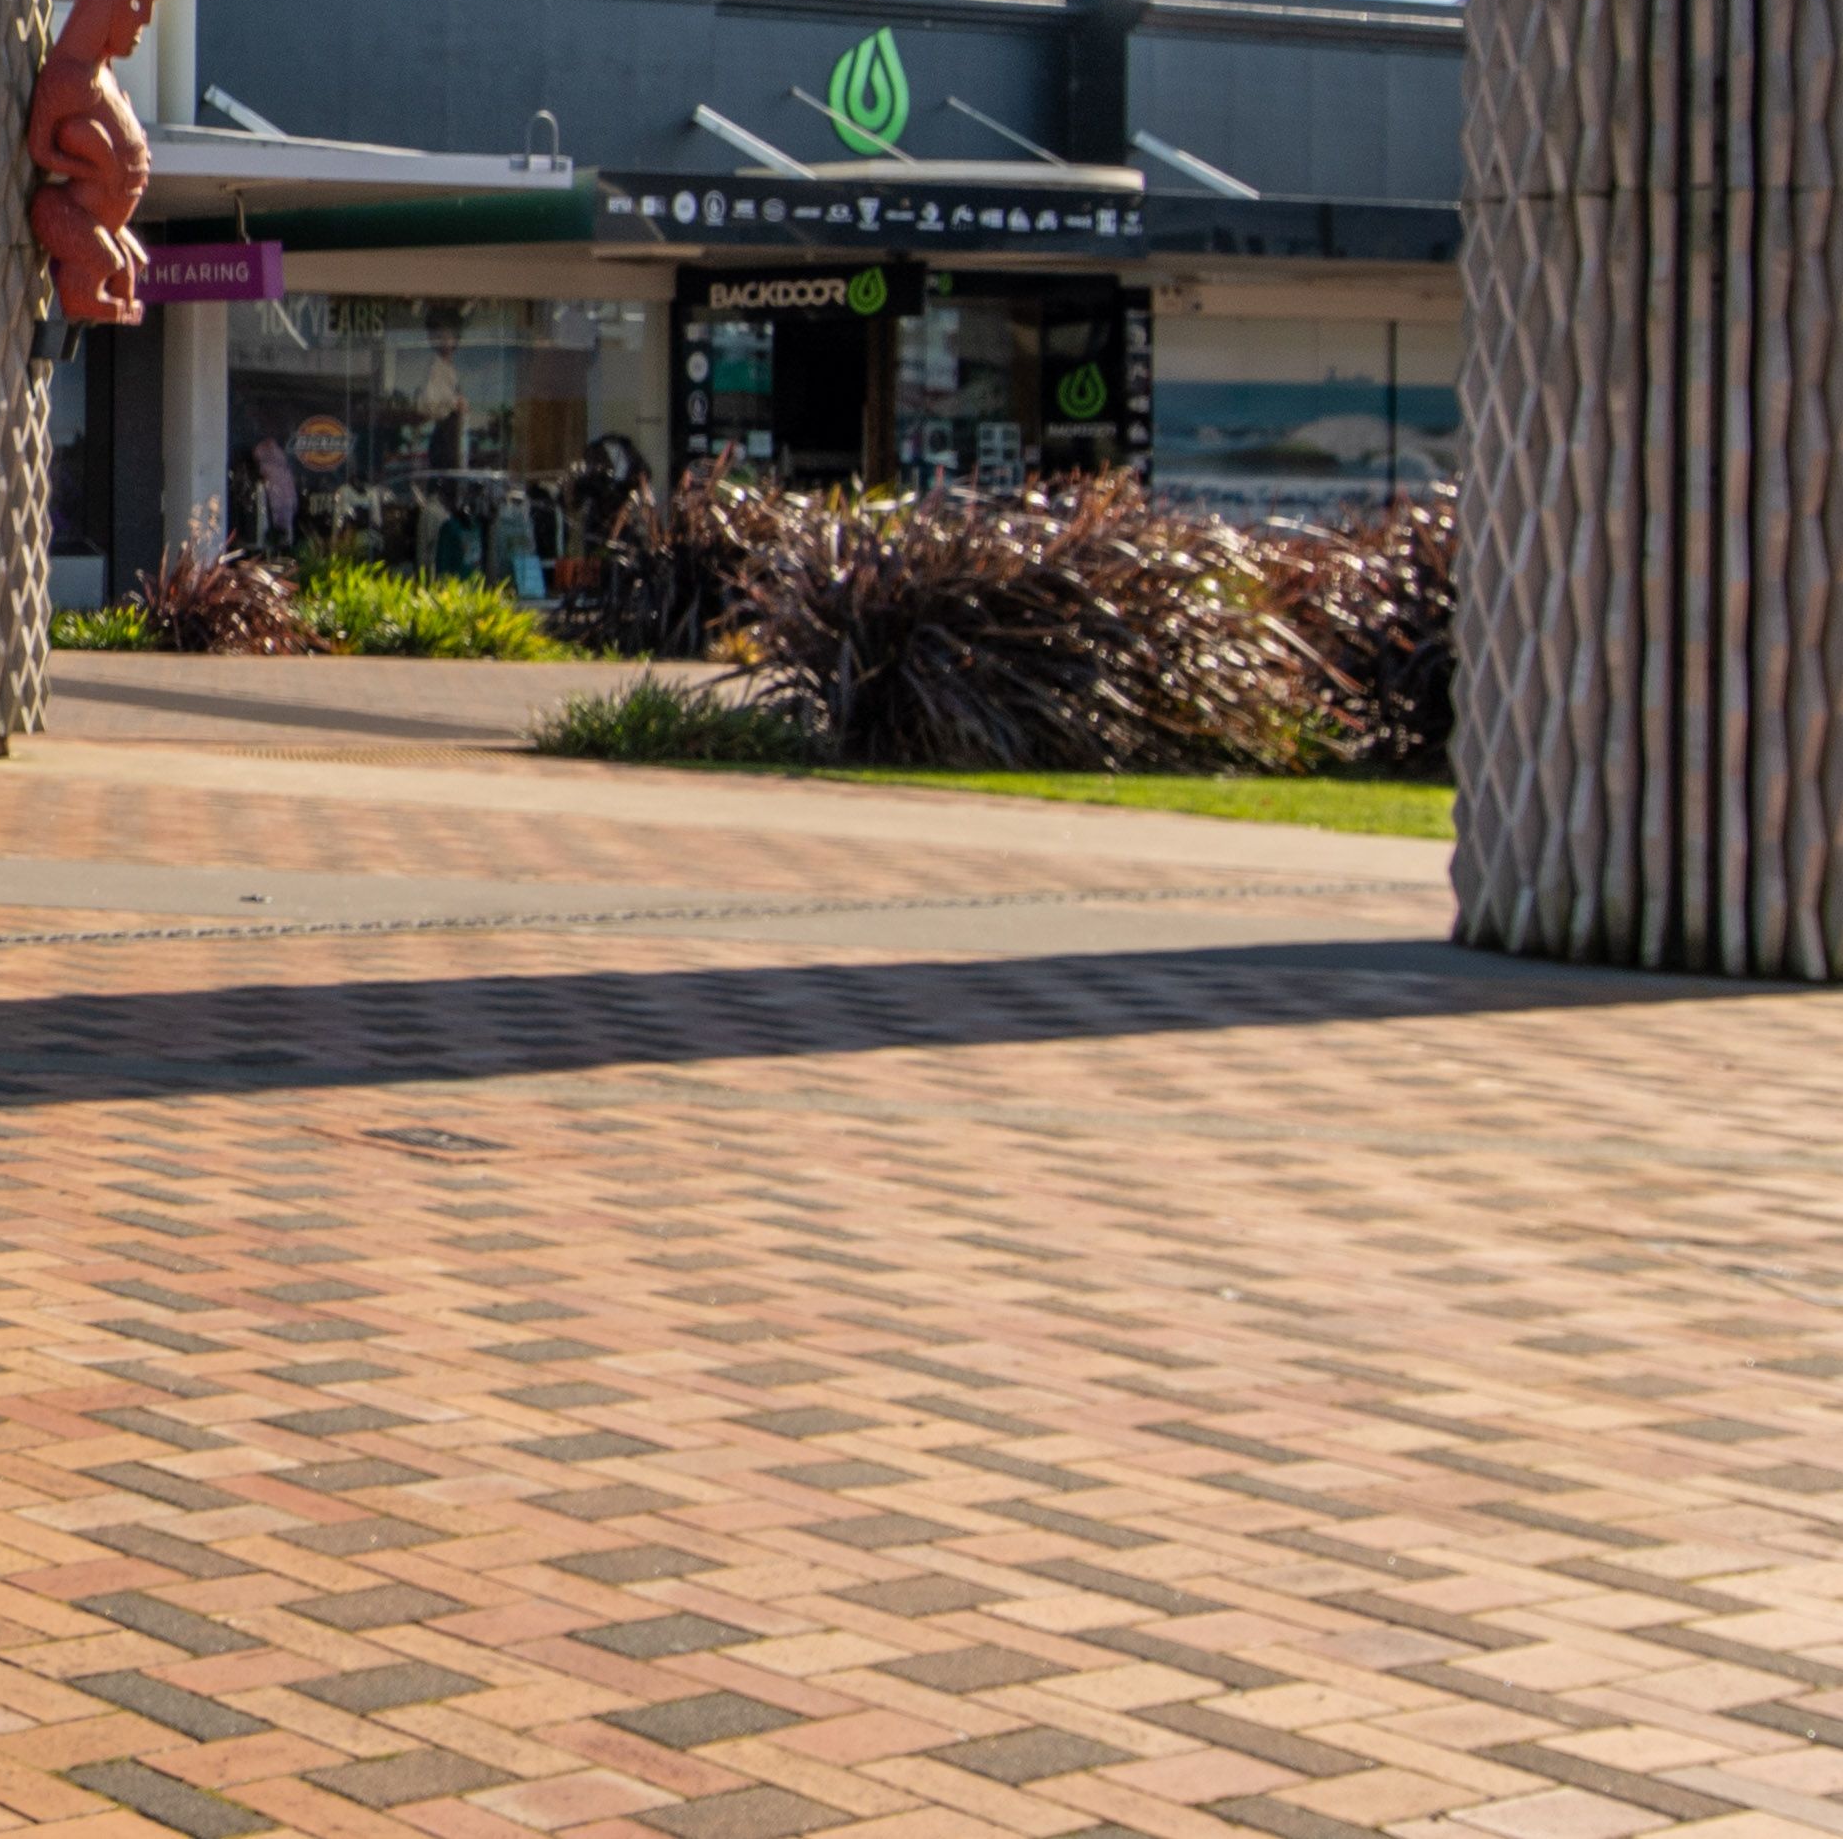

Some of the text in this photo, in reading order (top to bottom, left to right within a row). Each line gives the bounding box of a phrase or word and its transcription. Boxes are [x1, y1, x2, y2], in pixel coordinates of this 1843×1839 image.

[155, 261, 249, 284] HEARING
[709, 278, 846, 310] BACKDOOR
[307, 297, 385, 338] YEARS
